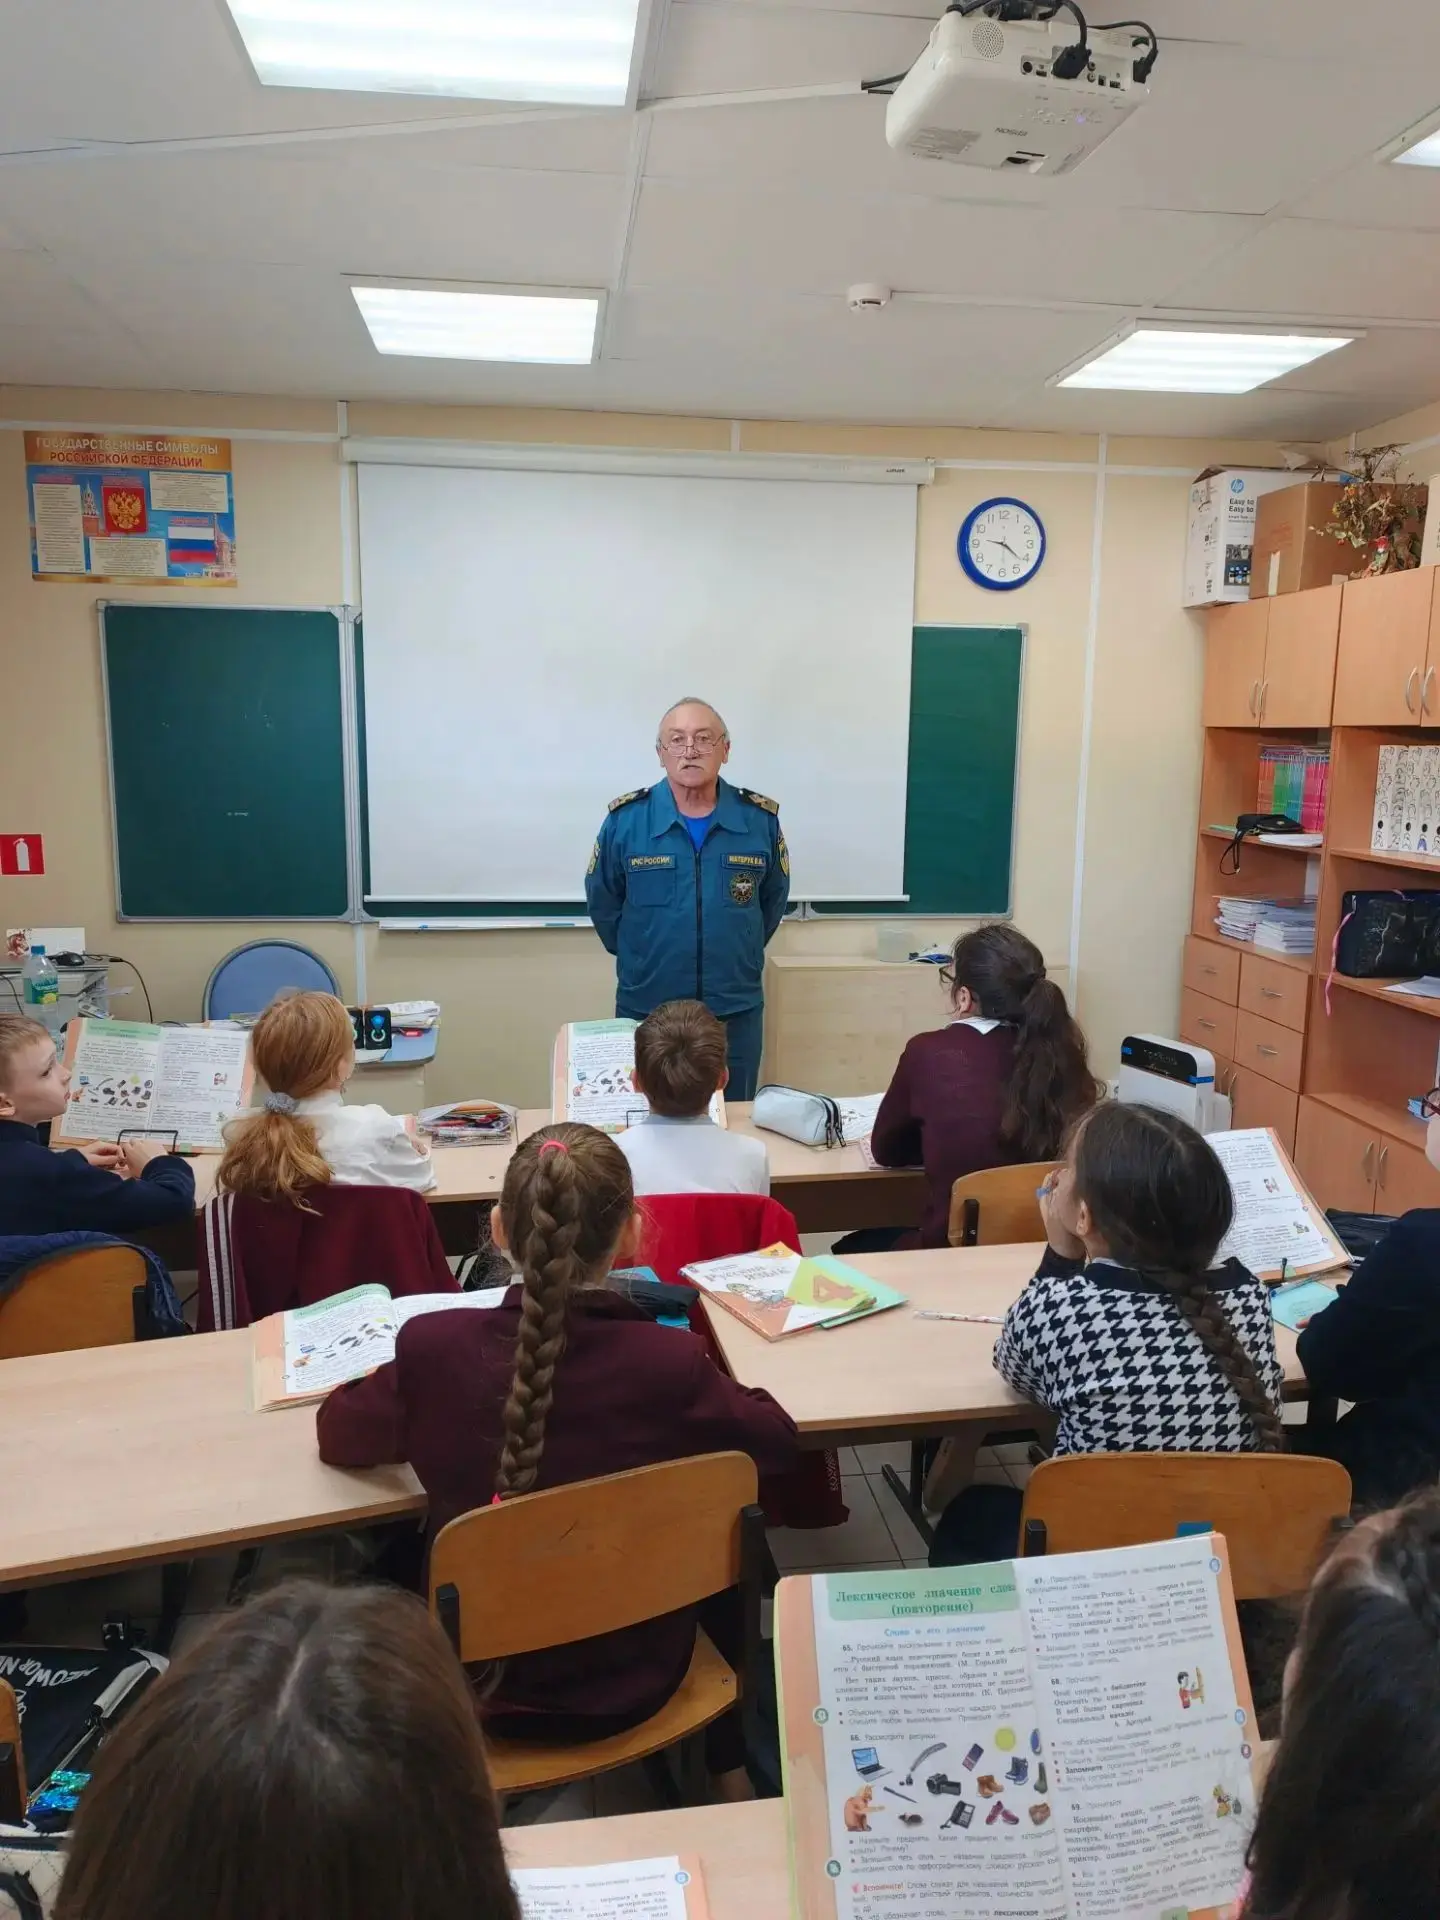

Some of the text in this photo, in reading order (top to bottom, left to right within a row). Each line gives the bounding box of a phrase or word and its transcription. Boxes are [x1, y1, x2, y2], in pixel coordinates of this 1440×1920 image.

[36, 437, 218, 454] ГОСУДАРСТВЕННЫЕ СИМВОЛЫ
[50, 452, 203, 467] РОССИЙСКОЙ ФЕДЕРАЦИИ
[1229, 498, 1246, 506] Easy
[1228, 505, 1244, 514] Easy
[987, 514, 995, 524] 11
[999, 510, 1010, 520] 12
[976, 524, 986, 533] 10
[1023, 525, 1031, 534] 2
[971, 538, 980, 548] 9
[1026, 540, 1034, 549] 3
[975, 553, 984, 563] 8
[1022, 553, 1030, 563] 4
[985, 564, 993, 573] 7
[998, 568, 1006, 577] 6
[1012, 563, 1020, 574] 5
[835, 1590, 916, 1603] Лексическое
[924, 1586, 982, 1600] значение
[891, 1600, 974, 1616] (повторение)
